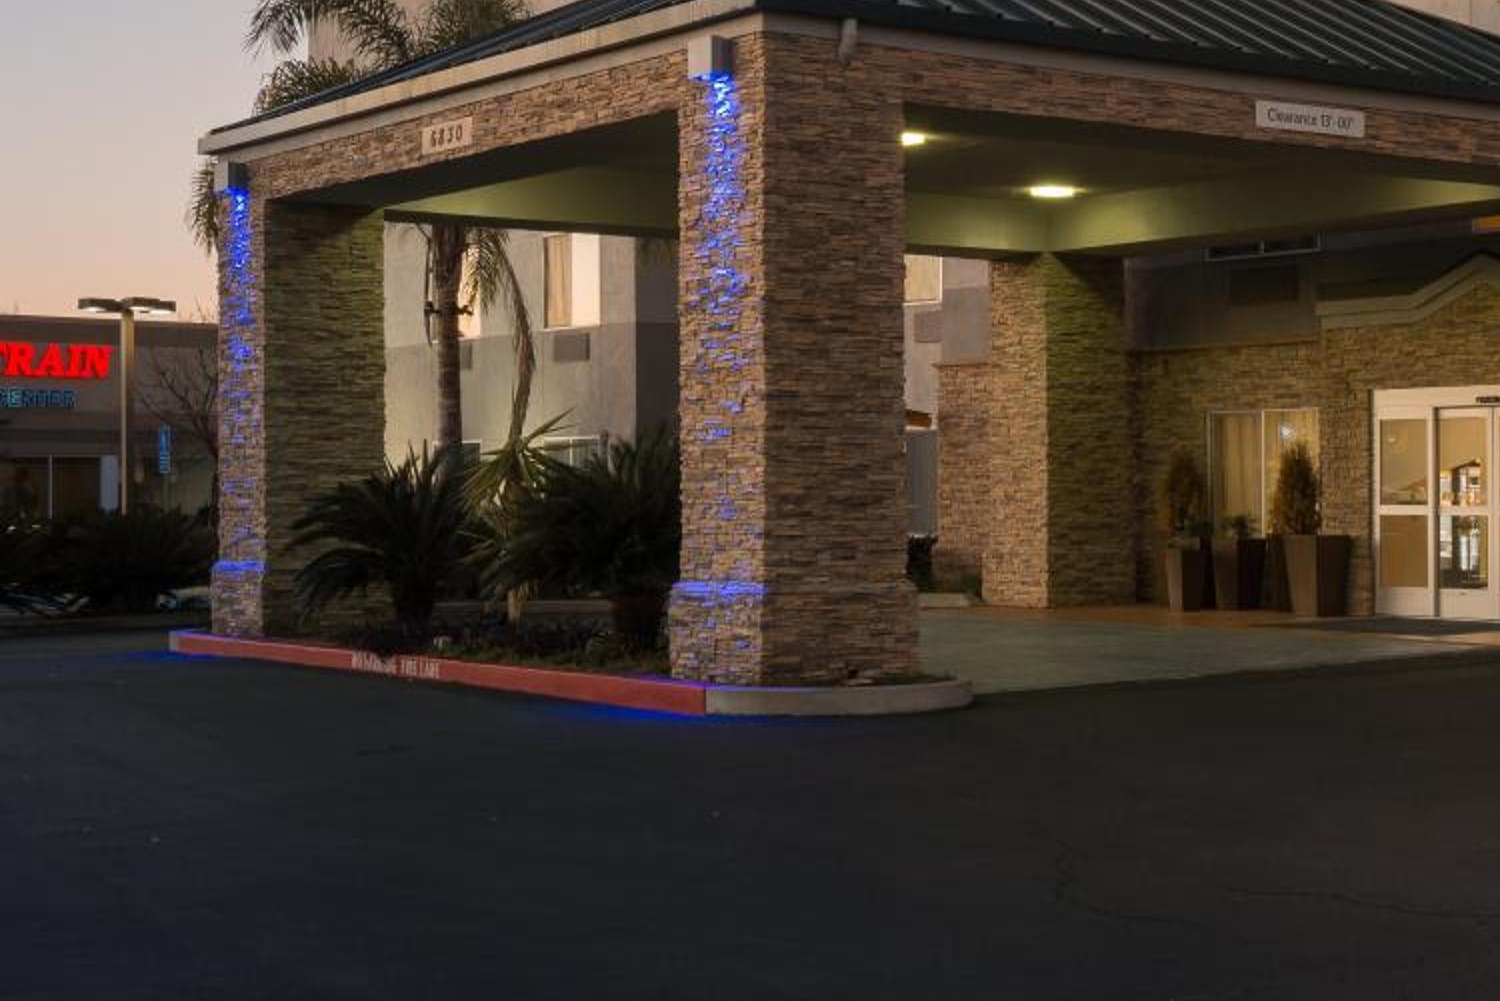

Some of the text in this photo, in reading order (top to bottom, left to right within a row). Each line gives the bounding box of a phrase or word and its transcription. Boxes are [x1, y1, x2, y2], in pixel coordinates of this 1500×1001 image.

[1266, 106, 1318, 126] Clearance
[430, 124, 463, 148] 6830
[419, 660, 439, 679] LANE
